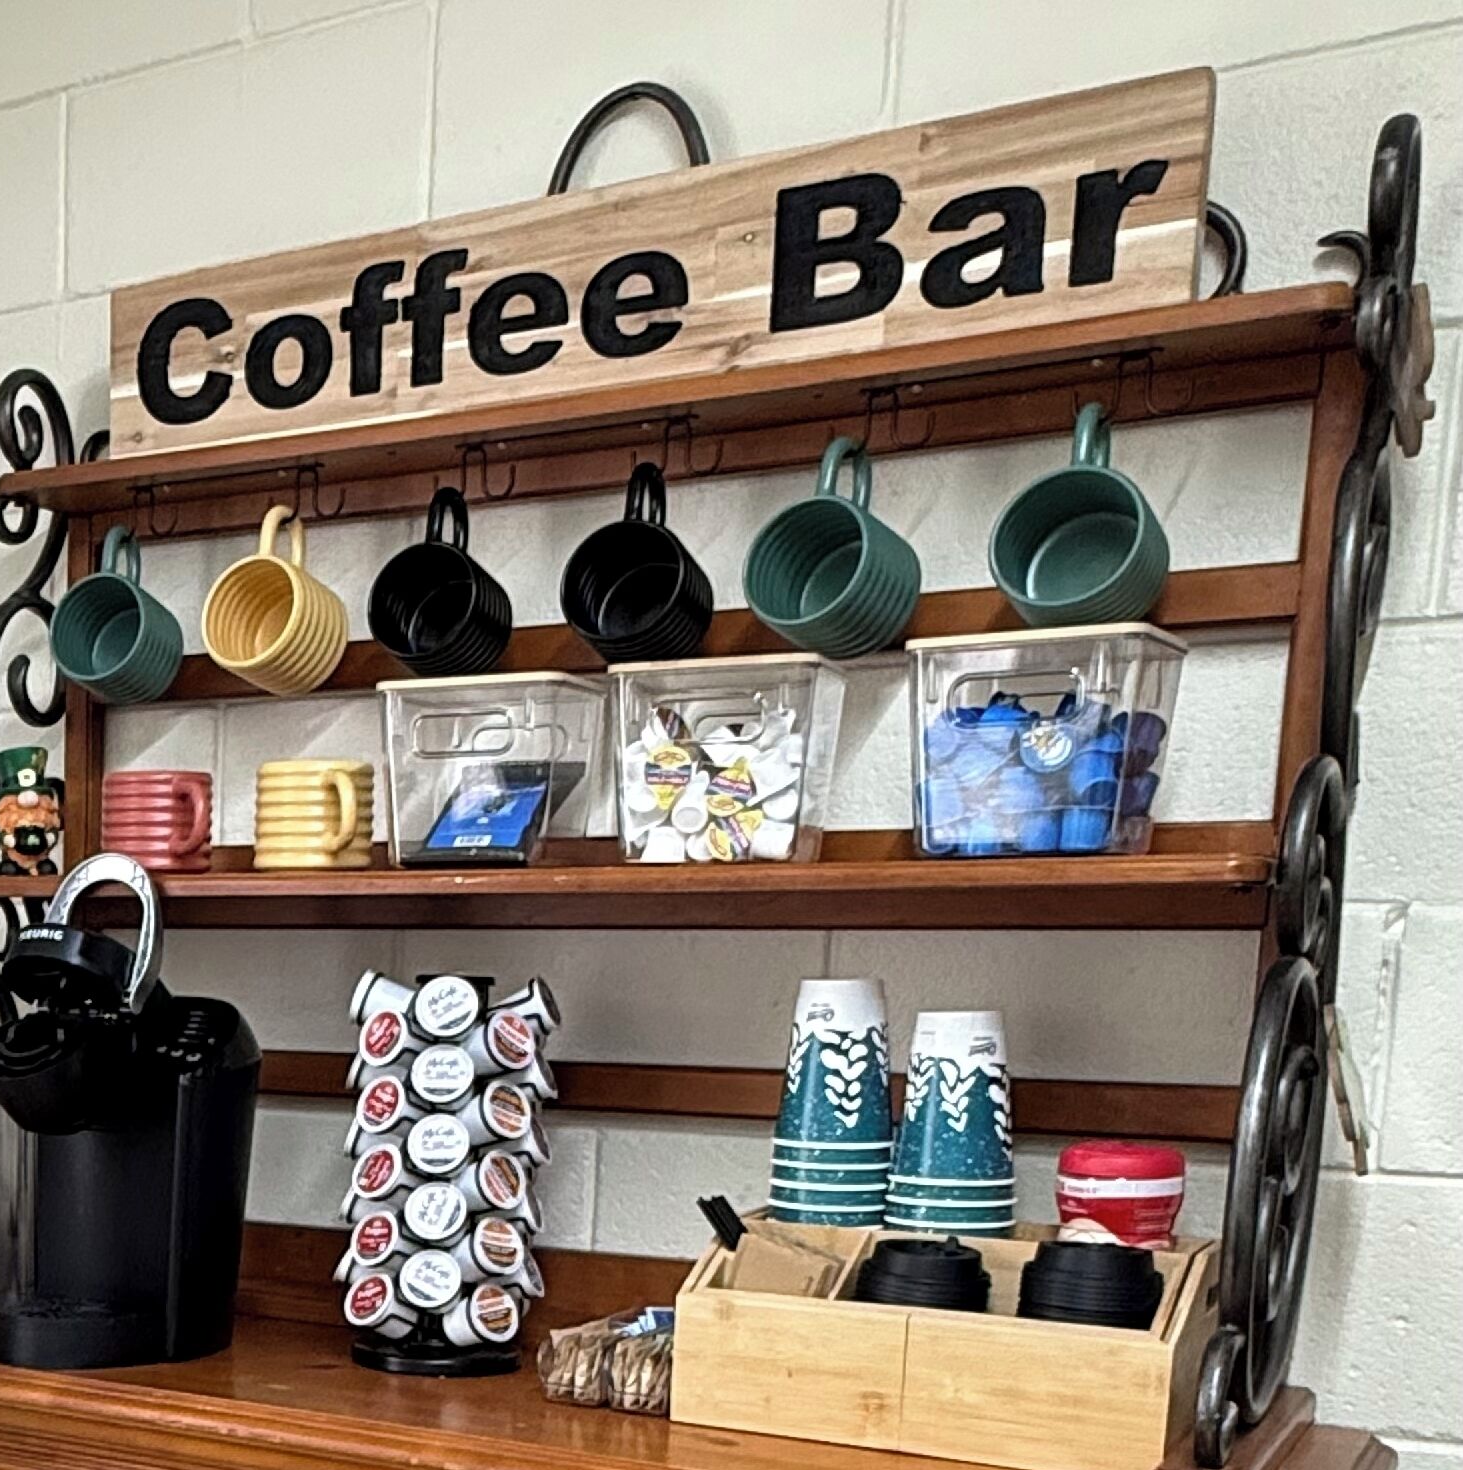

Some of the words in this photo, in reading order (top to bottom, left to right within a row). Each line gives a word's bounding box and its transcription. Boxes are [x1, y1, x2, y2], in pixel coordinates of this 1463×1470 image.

[137, 248, 689, 425] Coffee
[770, 158, 1169, 333] Bar
[19, 927, 64, 941] KEURIG
